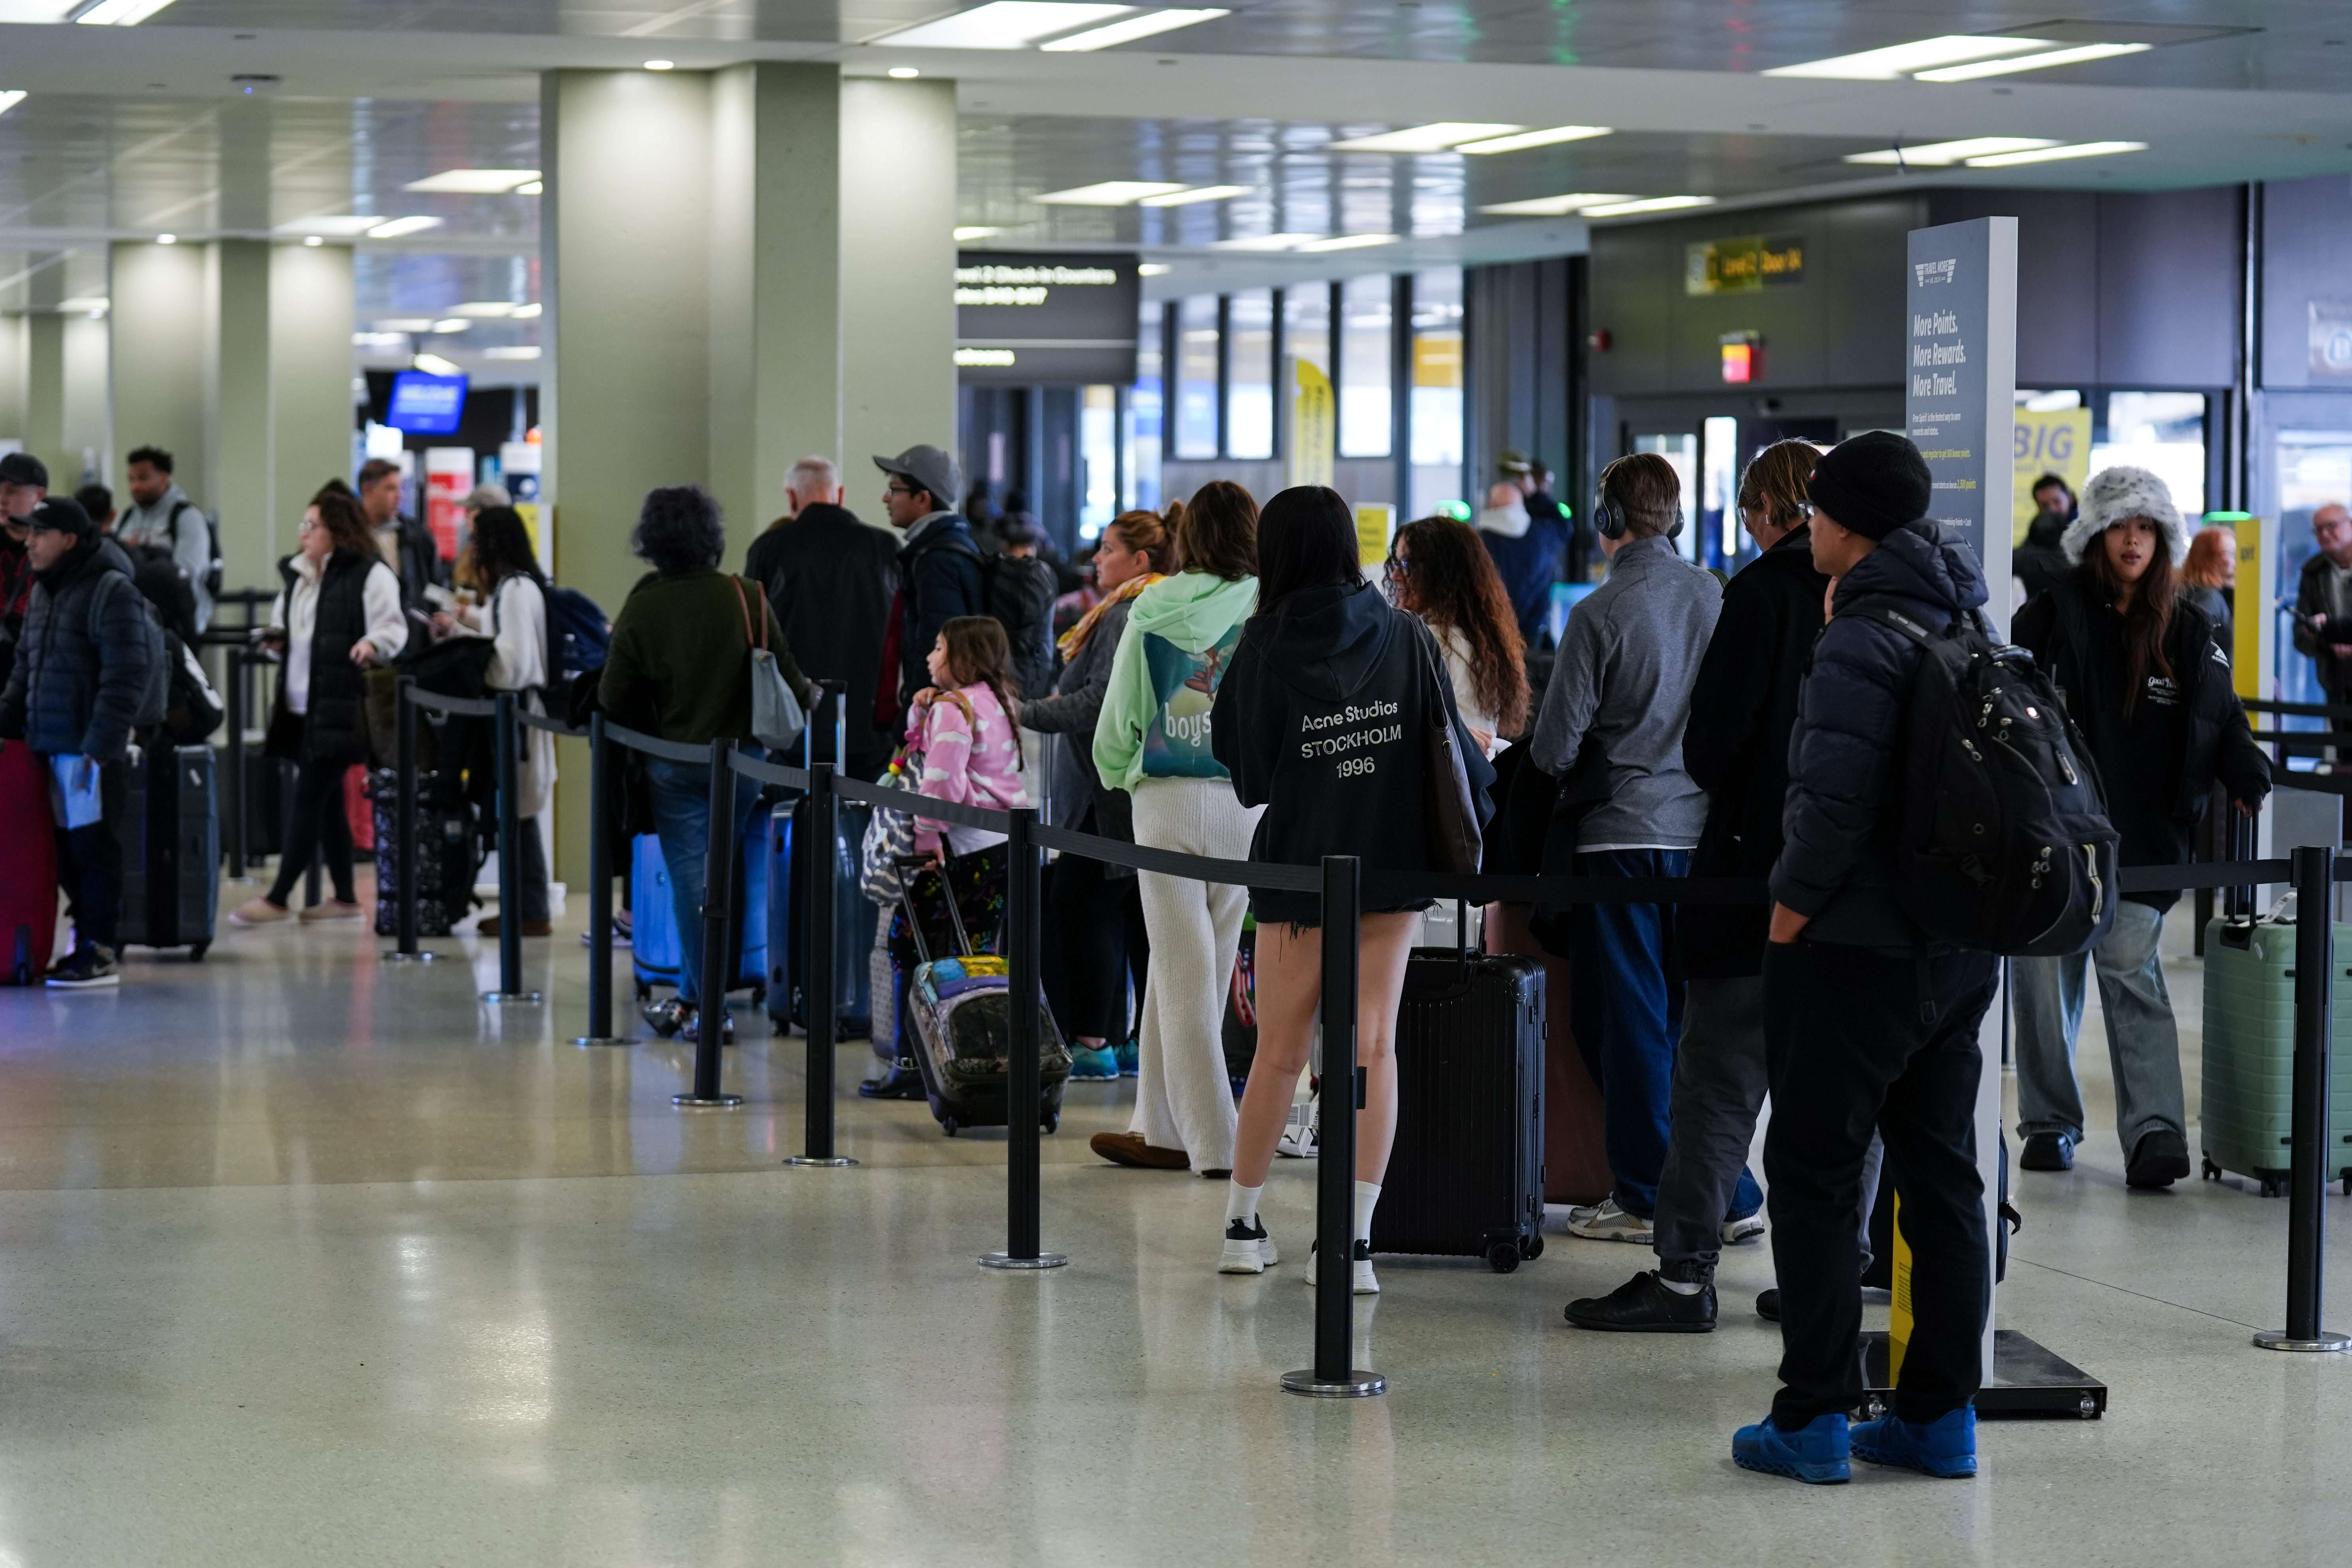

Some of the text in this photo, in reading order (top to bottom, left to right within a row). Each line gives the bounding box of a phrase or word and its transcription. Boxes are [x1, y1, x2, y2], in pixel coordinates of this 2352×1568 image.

[1924, 260, 1948, 275] TRAVEL MORE
[1913, 309, 1958, 337] More Points.
[1913, 339, 1966, 367] More Rewards.
[1913, 370, 1957, 397] More Travel.
[1935, 412, 1945, 422] fastest
[1951, 412, 1954, 421] to
[1913, 427, 1924, 436] rewards
[2014, 425, 2073, 459] BIG
[1928, 449, 1939, 460] register
[1939, 449, 1942, 458] to
[1953, 448, 1961, 457] bonus
[1957, 479, 1966, 491] 2,500
[1966, 478, 1976, 491] points
[1955, 517, 1963, 526] Points
[1164, 701, 1212, 747] boys
[1302, 700, 1398, 732] Acne Studios
[1301, 724, 1402, 758] STOCKHOLM
[1336, 757, 1375, 779] 1996
